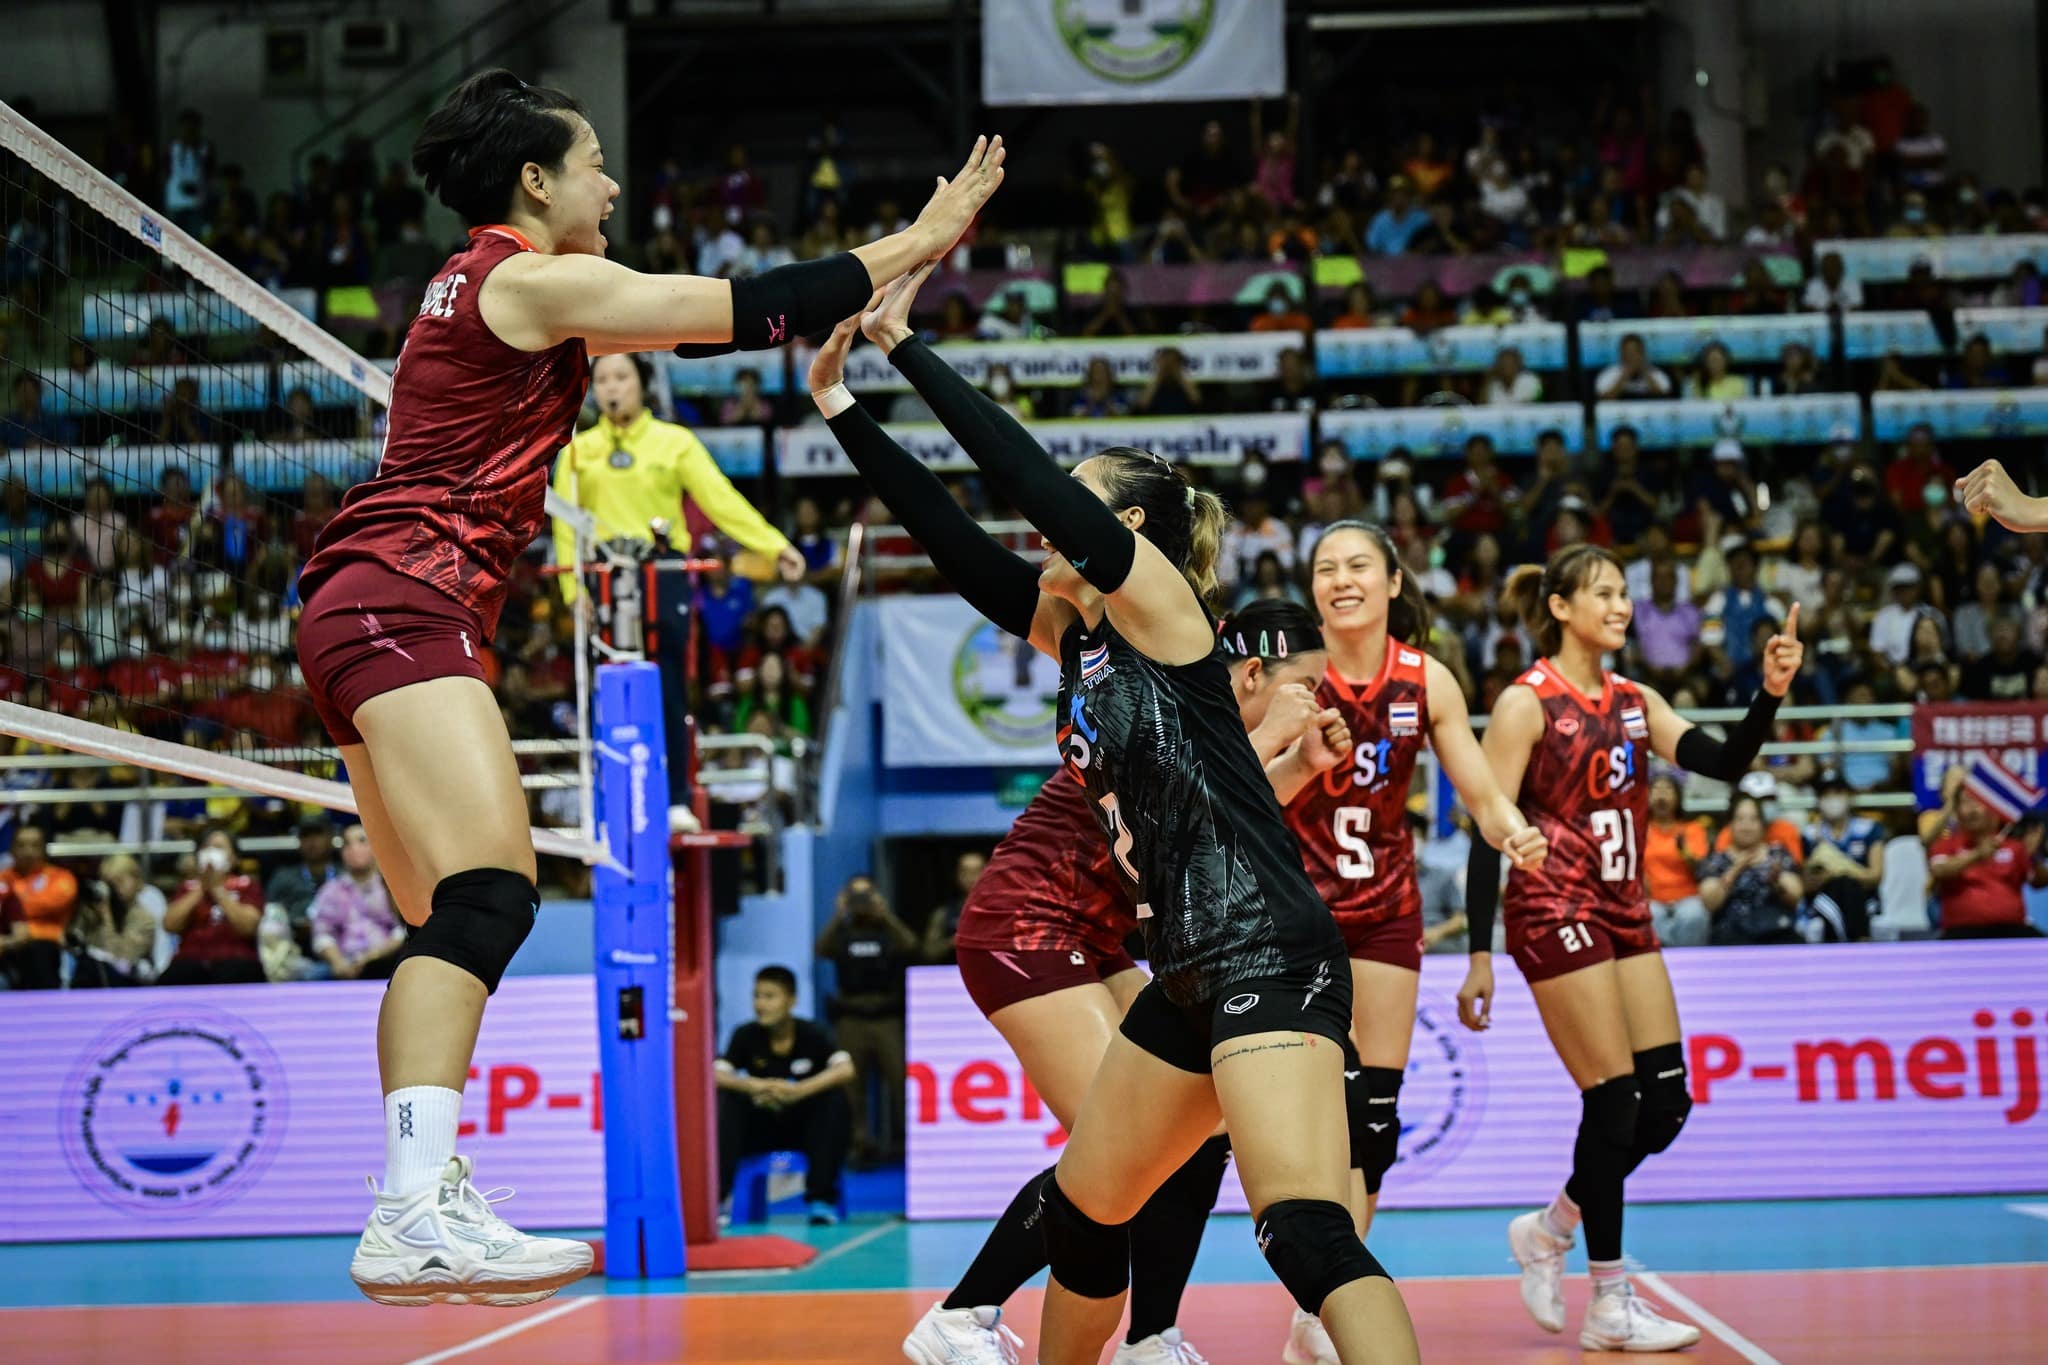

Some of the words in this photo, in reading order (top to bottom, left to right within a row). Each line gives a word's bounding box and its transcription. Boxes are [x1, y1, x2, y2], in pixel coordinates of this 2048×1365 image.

[1083, 664, 1117, 690] THA
[1322, 737, 1393, 798] est
[1587, 740, 1635, 800] est
[1333, 806, 1375, 880] 5
[1590, 808, 1637, 882] 21
[1558, 922, 1594, 953] 21
[1687, 1008, 2048, 1124] P-meij
